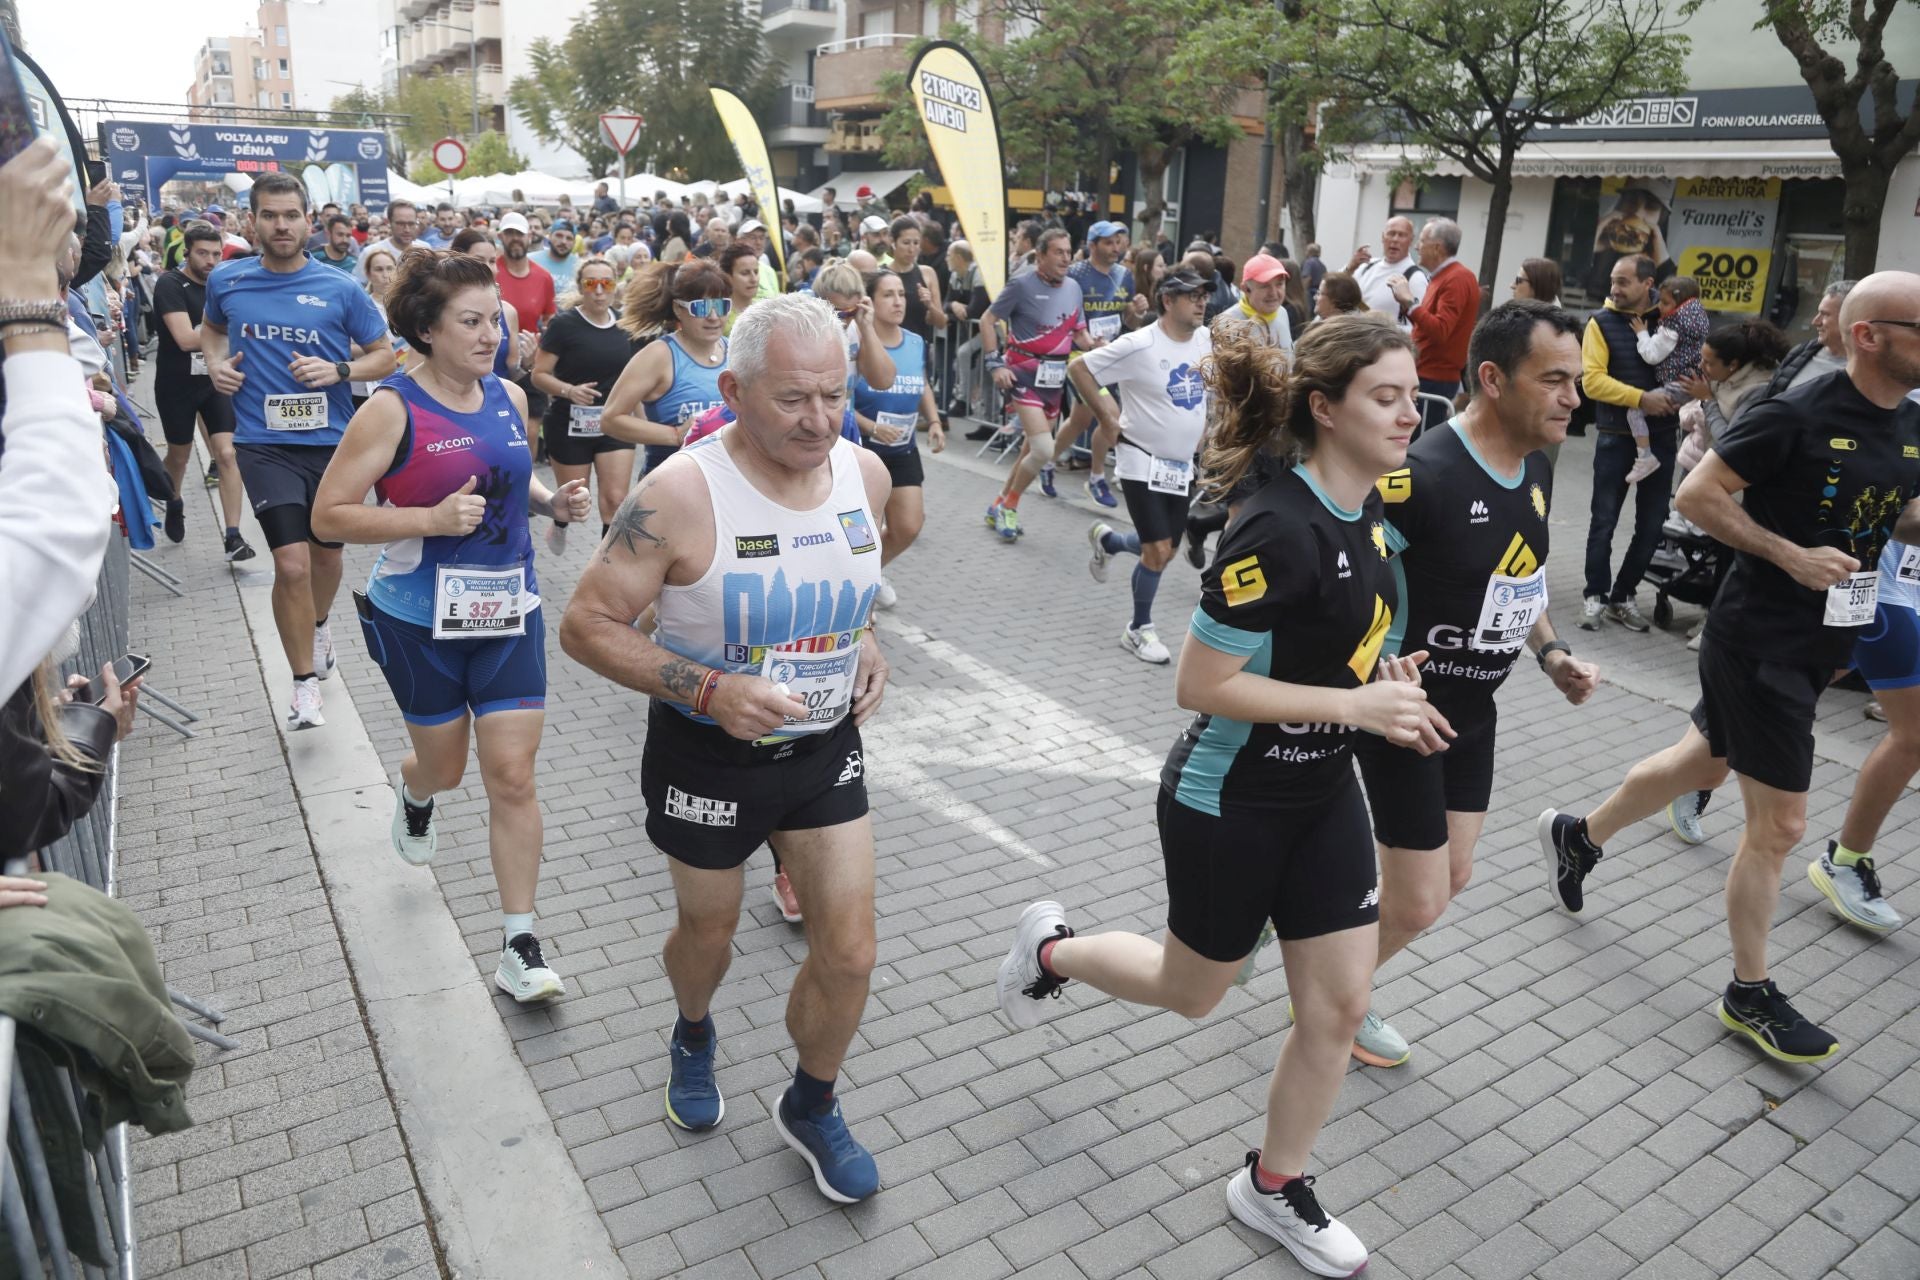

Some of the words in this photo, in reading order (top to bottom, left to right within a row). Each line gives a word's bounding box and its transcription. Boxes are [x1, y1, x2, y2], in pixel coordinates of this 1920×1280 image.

[215, 132, 253, 143] VOLTA
[254, 134, 264, 143] A
[265, 135, 288, 144] PEU
[1762, 165, 1822, 176] PuraMasa
[1687, 185, 1766, 198] APERTURA
[1682, 208, 1766, 227] Fanneli's
[1726, 227, 1763, 237] burgers
[1693, 252, 1758, 279] 200
[1701, 289, 1752, 303] RATIS
[241, 322, 321, 345] ALPESA
[281, 405, 312, 417] 3658
[426, 436, 475, 452] excom
[1849, 588, 1870, 606] 3501
[449, 603, 458, 617] E
[469, 601, 503, 618] 357
[1491, 612, 1503, 627] E
[1508, 608, 1533, 628] 791
[798, 661, 826, 671] CIRCUIT
[833, 659, 846, 668] PEU
